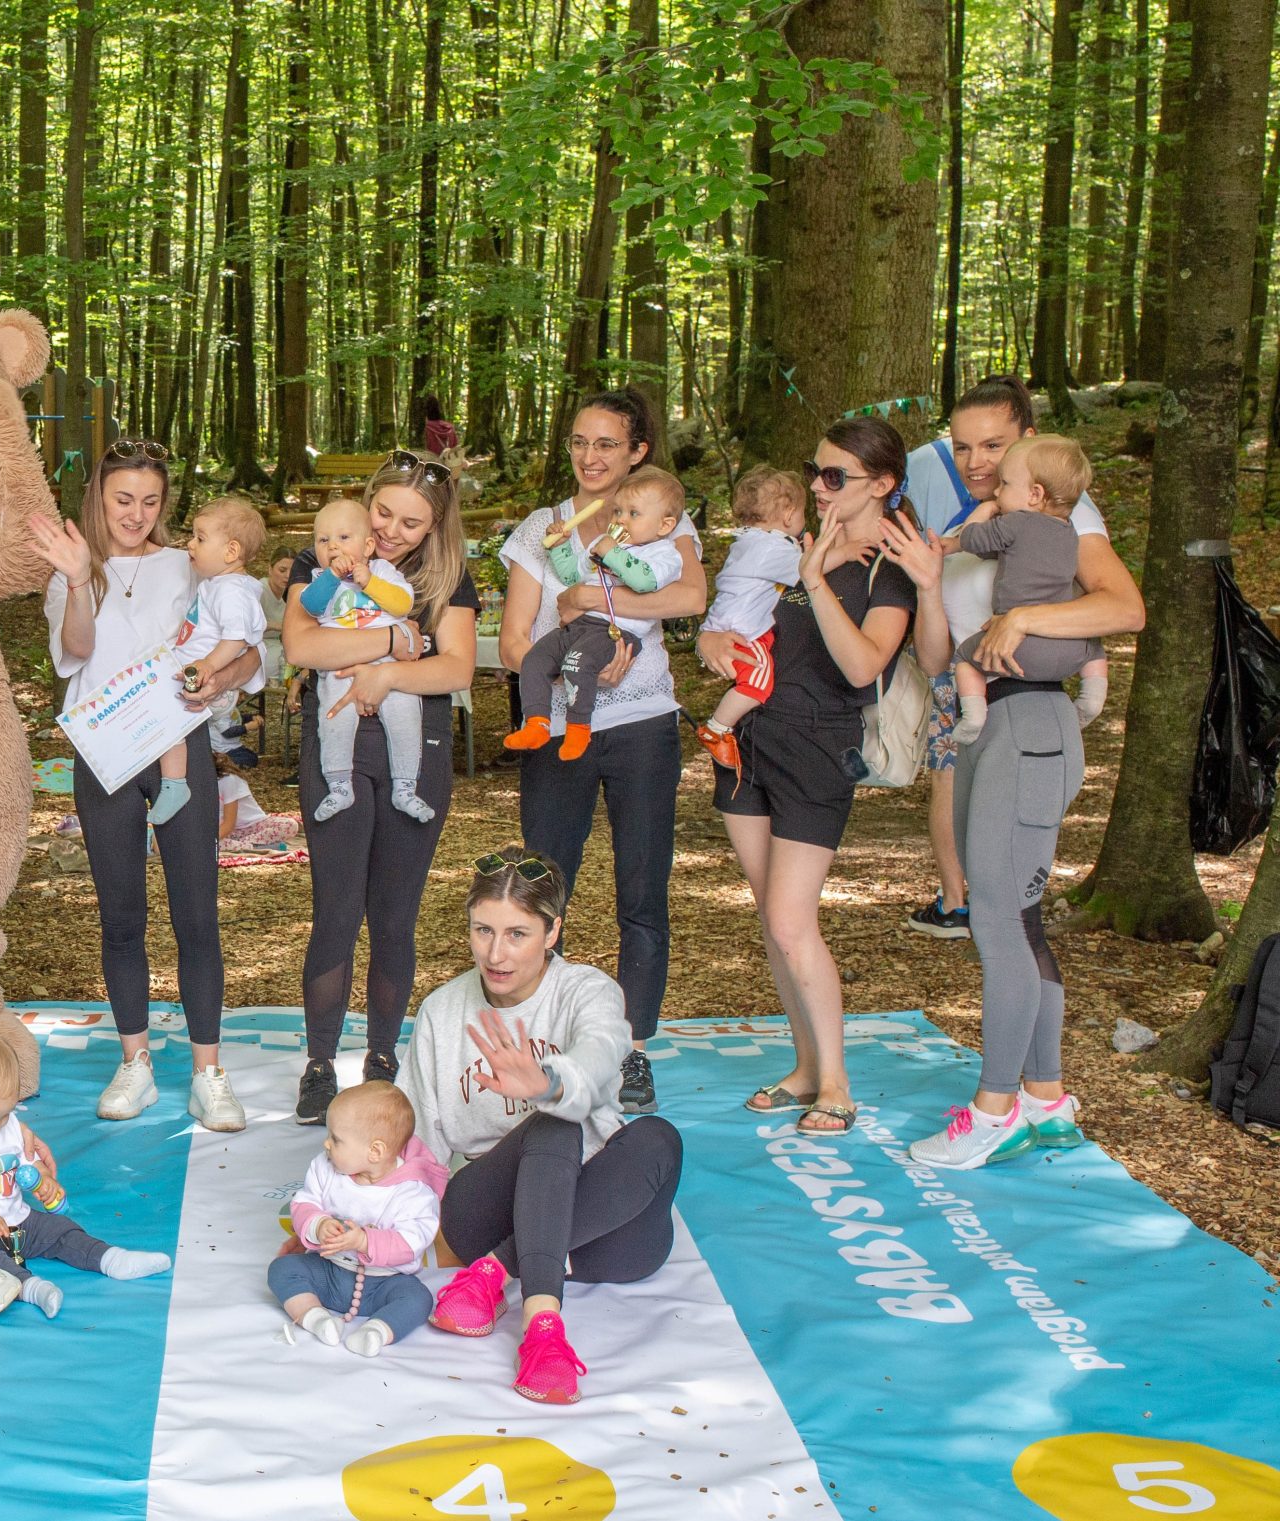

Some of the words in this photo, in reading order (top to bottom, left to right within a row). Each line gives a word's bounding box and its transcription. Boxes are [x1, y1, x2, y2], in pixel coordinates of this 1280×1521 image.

[97, 680, 147, 722] BABYSTEPS
[662, 1024, 792, 1036] CIL
[756, 1123, 974, 1323] BABYSTEPS
[917, 1190, 1039, 1274] poticanja
[1004, 1276, 1126, 1371] program
[431, 1463, 528, 1521] 4
[1112, 1461, 1216, 1514] 5
